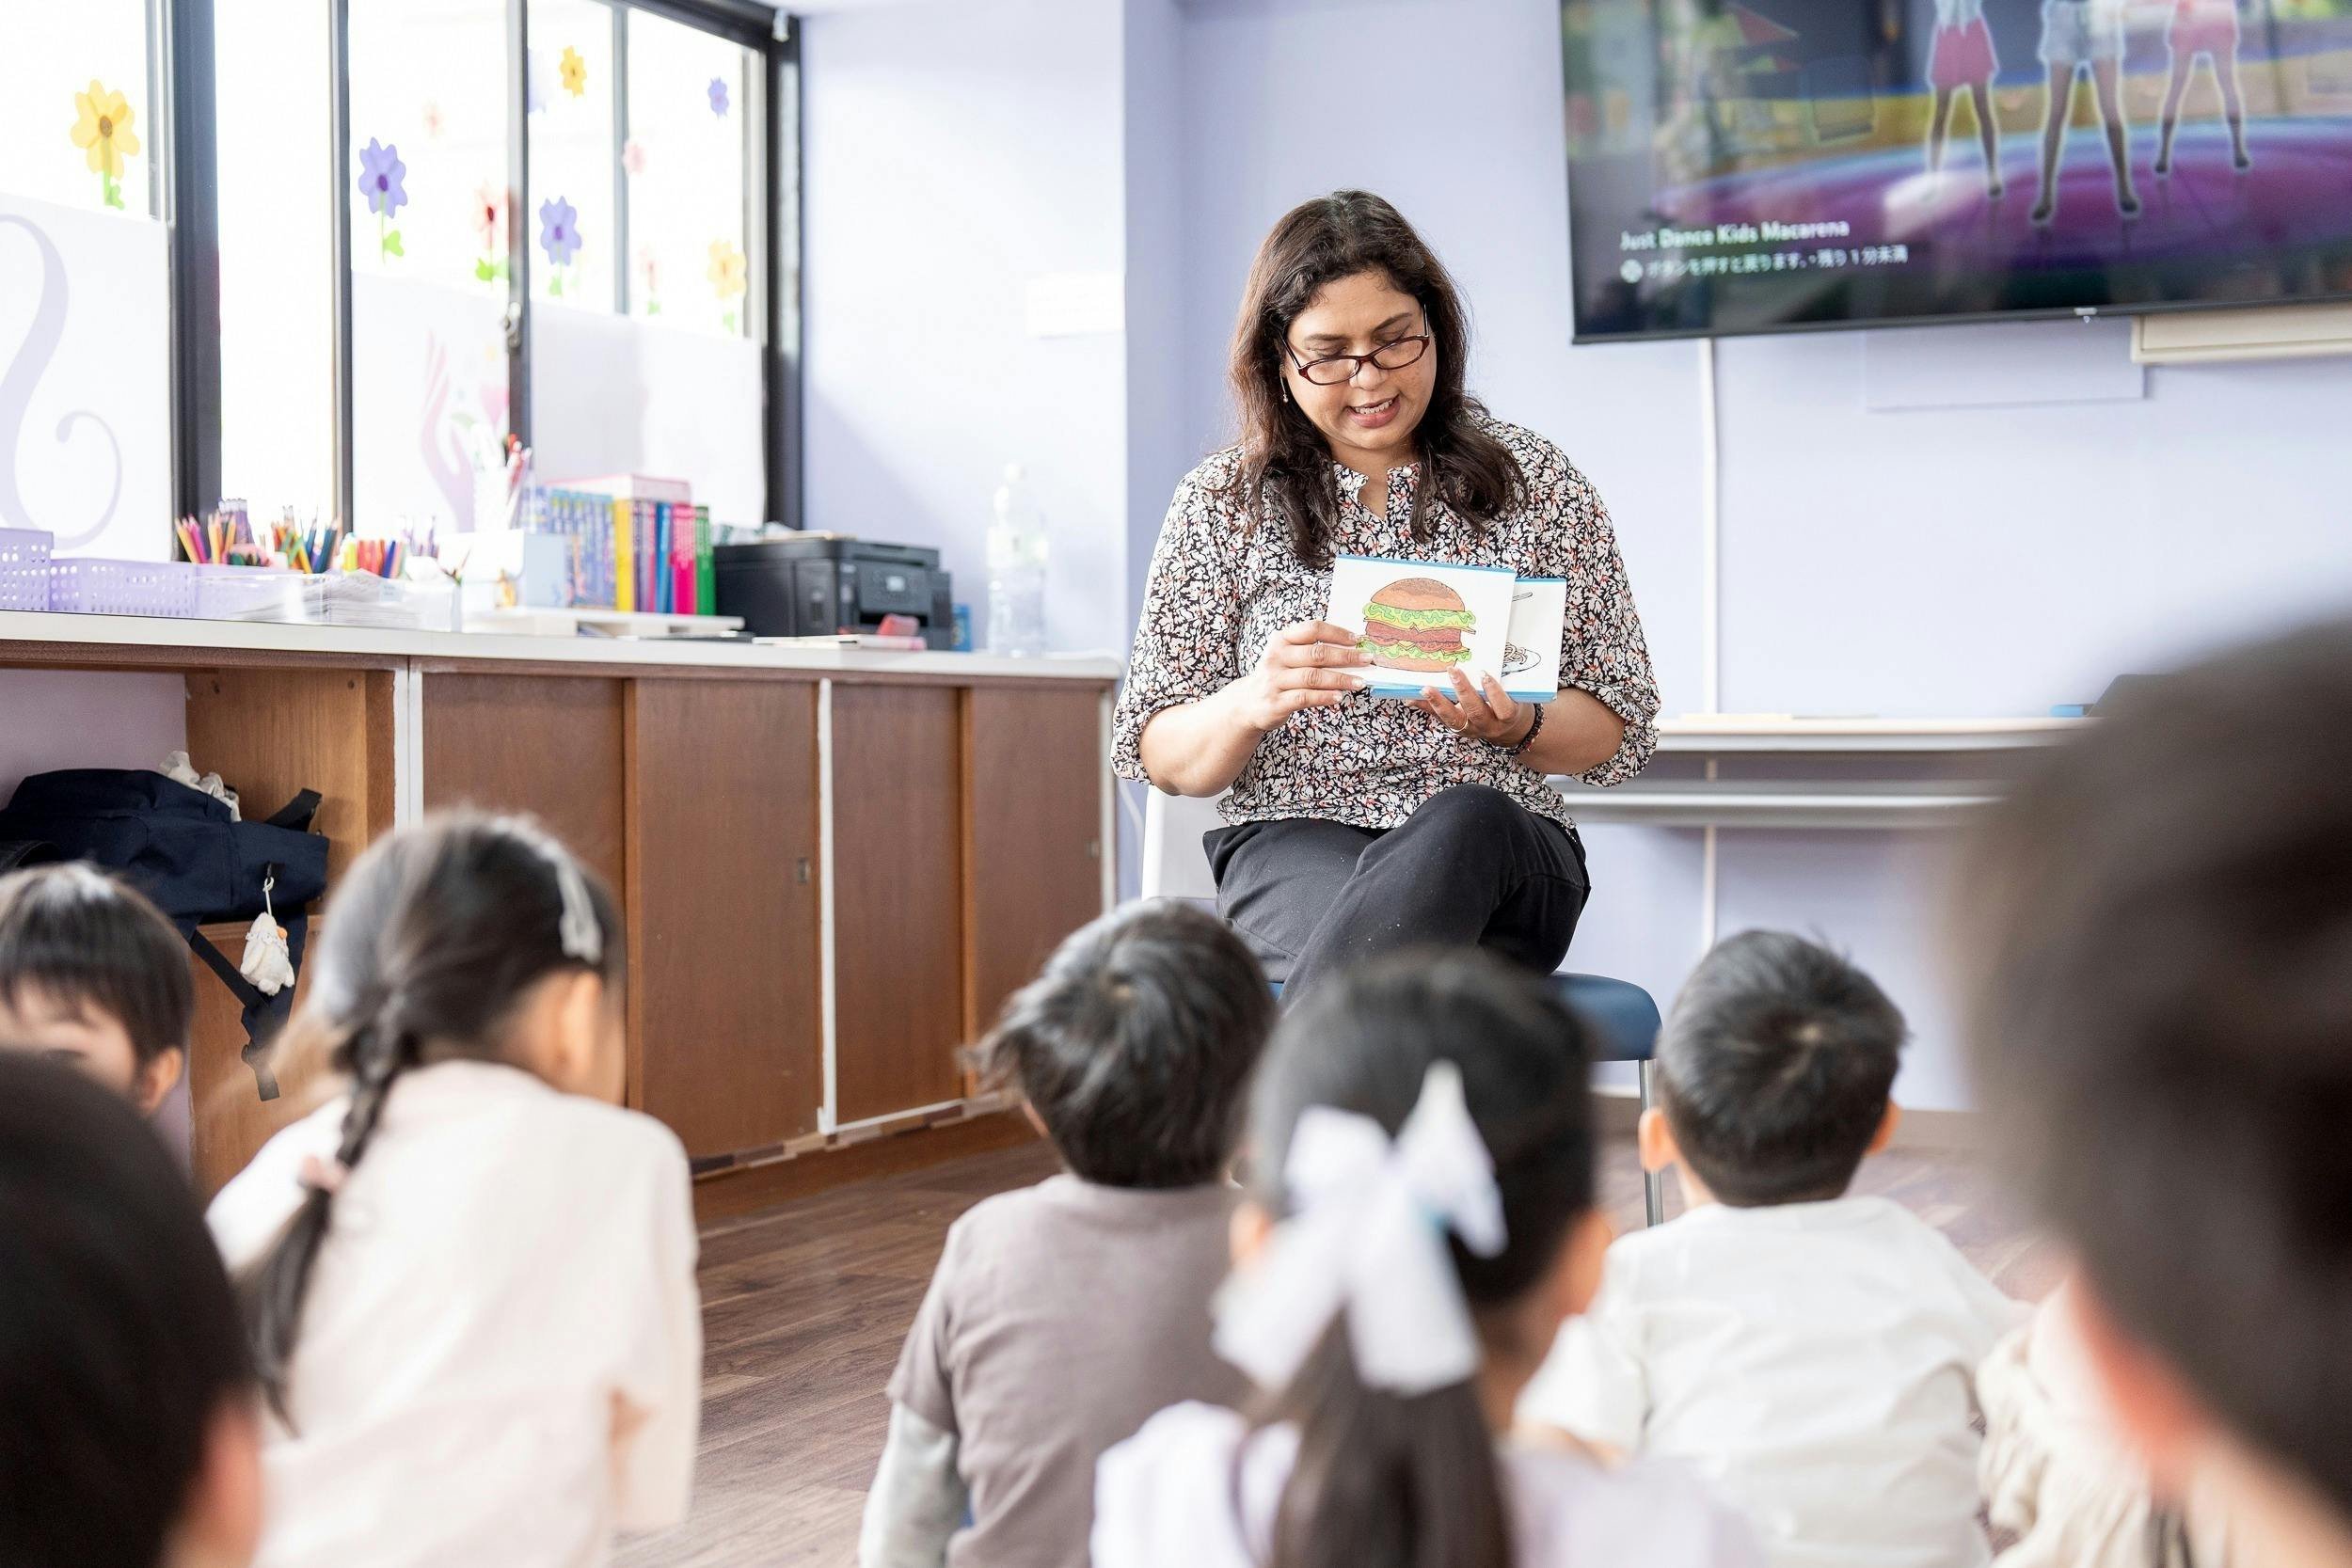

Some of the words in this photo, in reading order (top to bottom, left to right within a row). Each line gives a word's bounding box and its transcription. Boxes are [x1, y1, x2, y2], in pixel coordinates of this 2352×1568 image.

[1620, 230, 1657, 251] Just
[1658, 228, 1715, 248] Dance
[1717, 223, 1757, 245] Kids
[1760, 220, 1851, 242] Macarena
